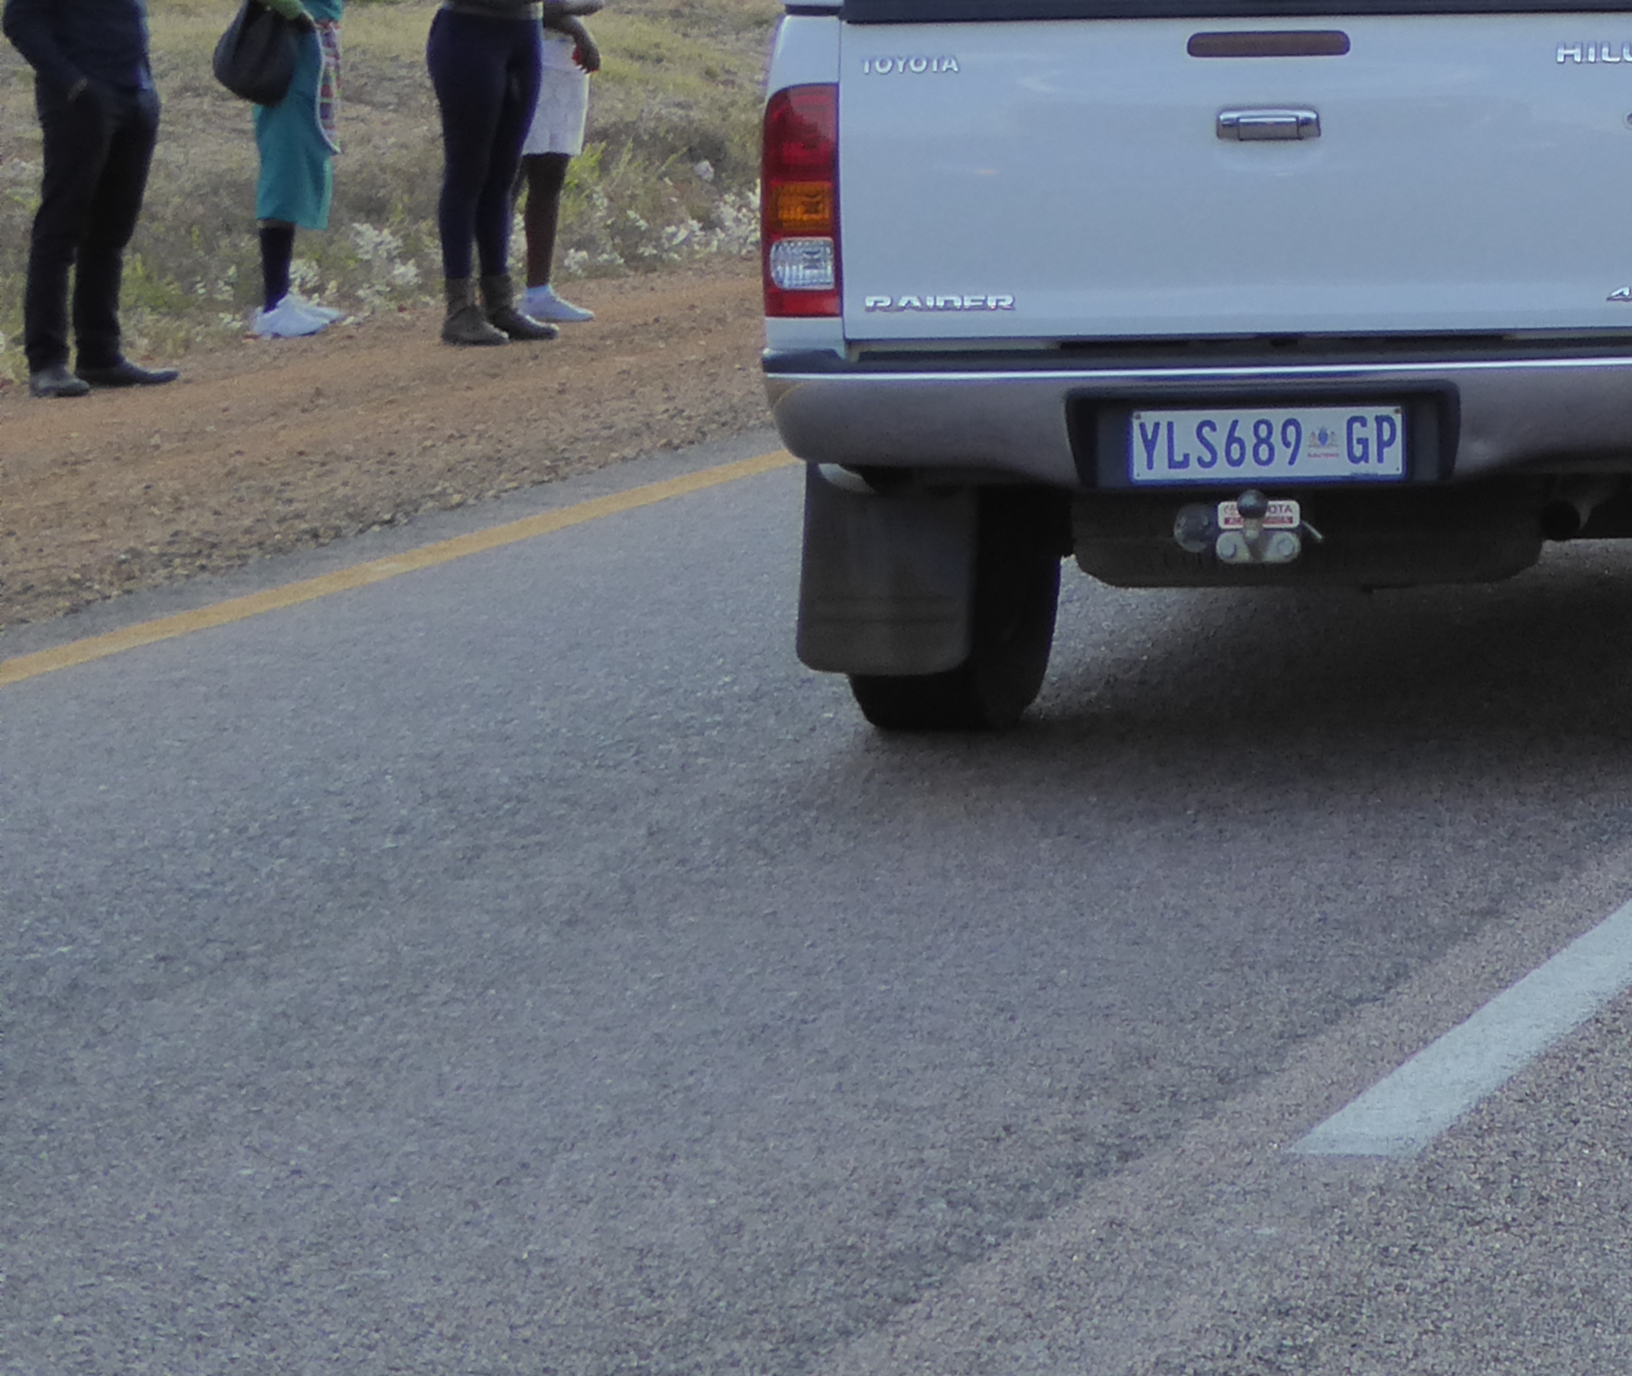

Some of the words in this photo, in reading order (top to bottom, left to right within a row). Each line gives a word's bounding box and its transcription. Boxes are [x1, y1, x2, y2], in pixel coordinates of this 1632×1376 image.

[861, 55, 960, 75] TOYOTA
[864, 295, 1016, 312] RAIDER
[1139, 418, 1302, 470] YLS689
[1346, 414, 1397, 465] GP
